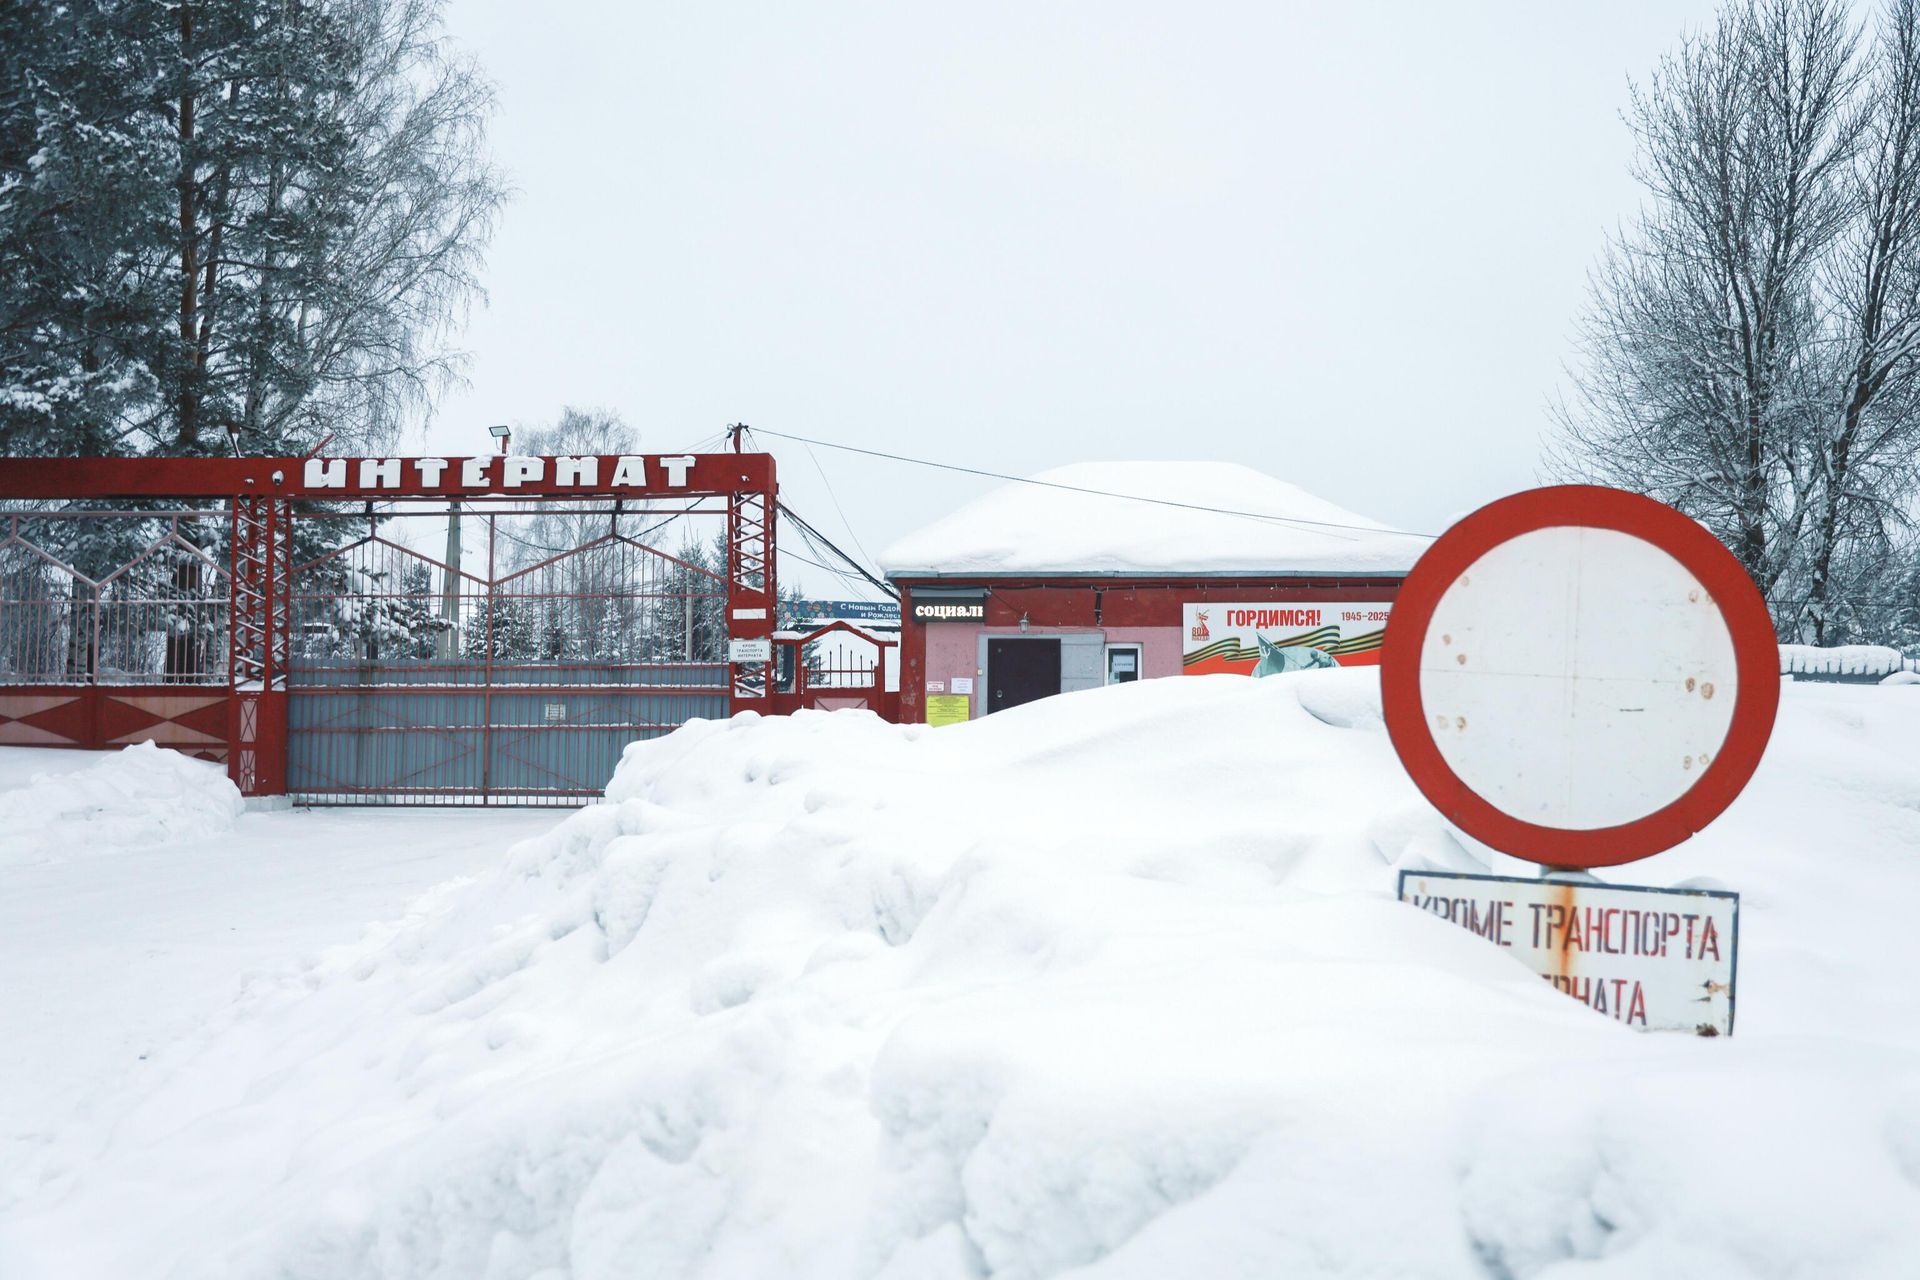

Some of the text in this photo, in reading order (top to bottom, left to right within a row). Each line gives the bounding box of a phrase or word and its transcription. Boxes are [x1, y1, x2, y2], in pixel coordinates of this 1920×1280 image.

[303, 457, 696, 489] ИНТЕРНАТ
[1226, 609, 1321, 629] ГОРДИМСЯ!
[1527, 902, 1720, 962] ТРАНСПОРТА
